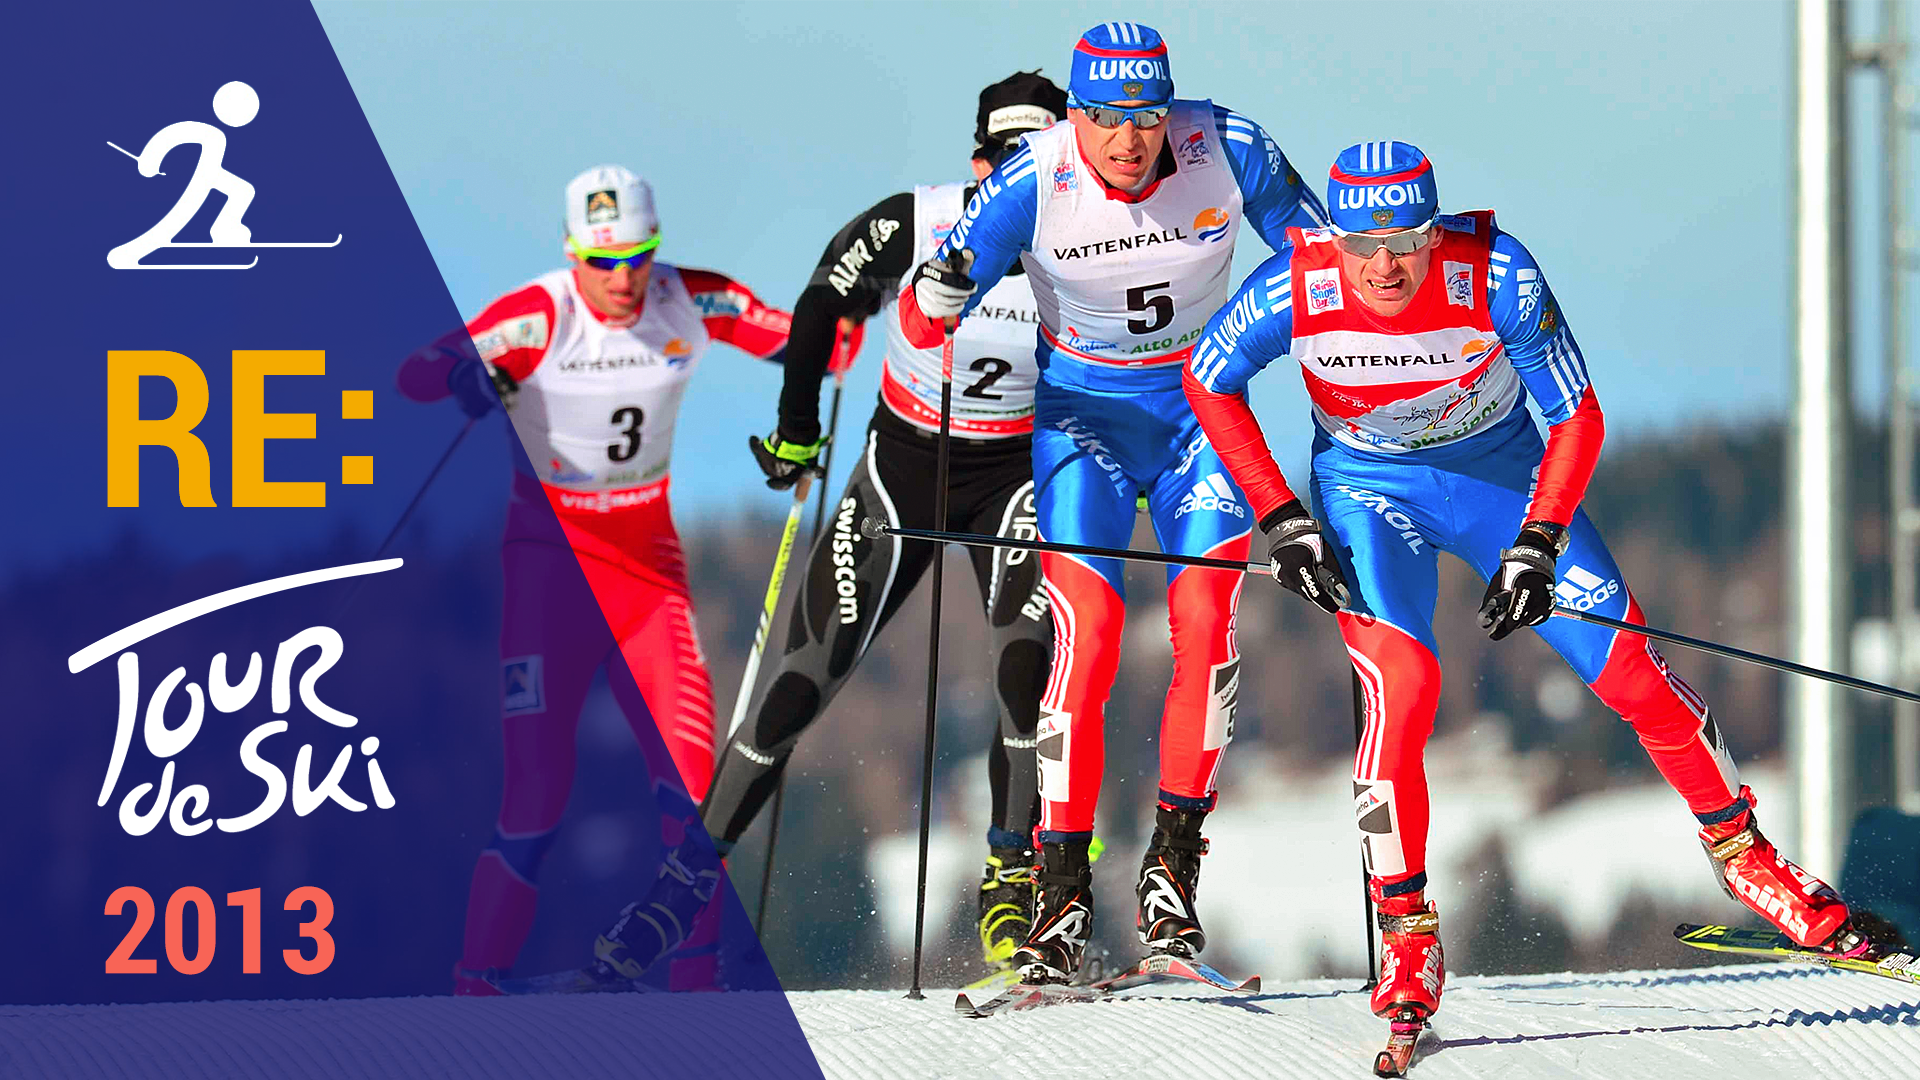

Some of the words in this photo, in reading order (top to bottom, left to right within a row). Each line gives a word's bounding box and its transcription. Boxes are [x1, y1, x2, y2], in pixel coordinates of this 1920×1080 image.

[1089, 60, 1167, 81] LUKOIL
[992, 112, 1041, 127] helvetia
[1338, 184, 1425, 210] LUKOIL
[1054, 227, 1188, 261] VATTENFALL
[1125, 281, 1176, 337] 5
[1311, 287, 1336, 300] Snow
[1519, 273, 1545, 322] adida
[1130, 337, 1173, 355] ALTO
[1316, 352, 1456, 370] VATTENFALL
[962, 357, 1013, 401] 2
[607, 406, 645, 464] 3
[1055, 416, 1129, 498] LUKOIL
[1174, 495, 1245, 520] adidas
[832, 497, 862, 625] swisscom
[1299, 566, 1320, 598] adidas
[1556, 579, 1619, 612] didas
[1512, 588, 1531, 621] adidas
[1362, 835, 1374, 871] 1
